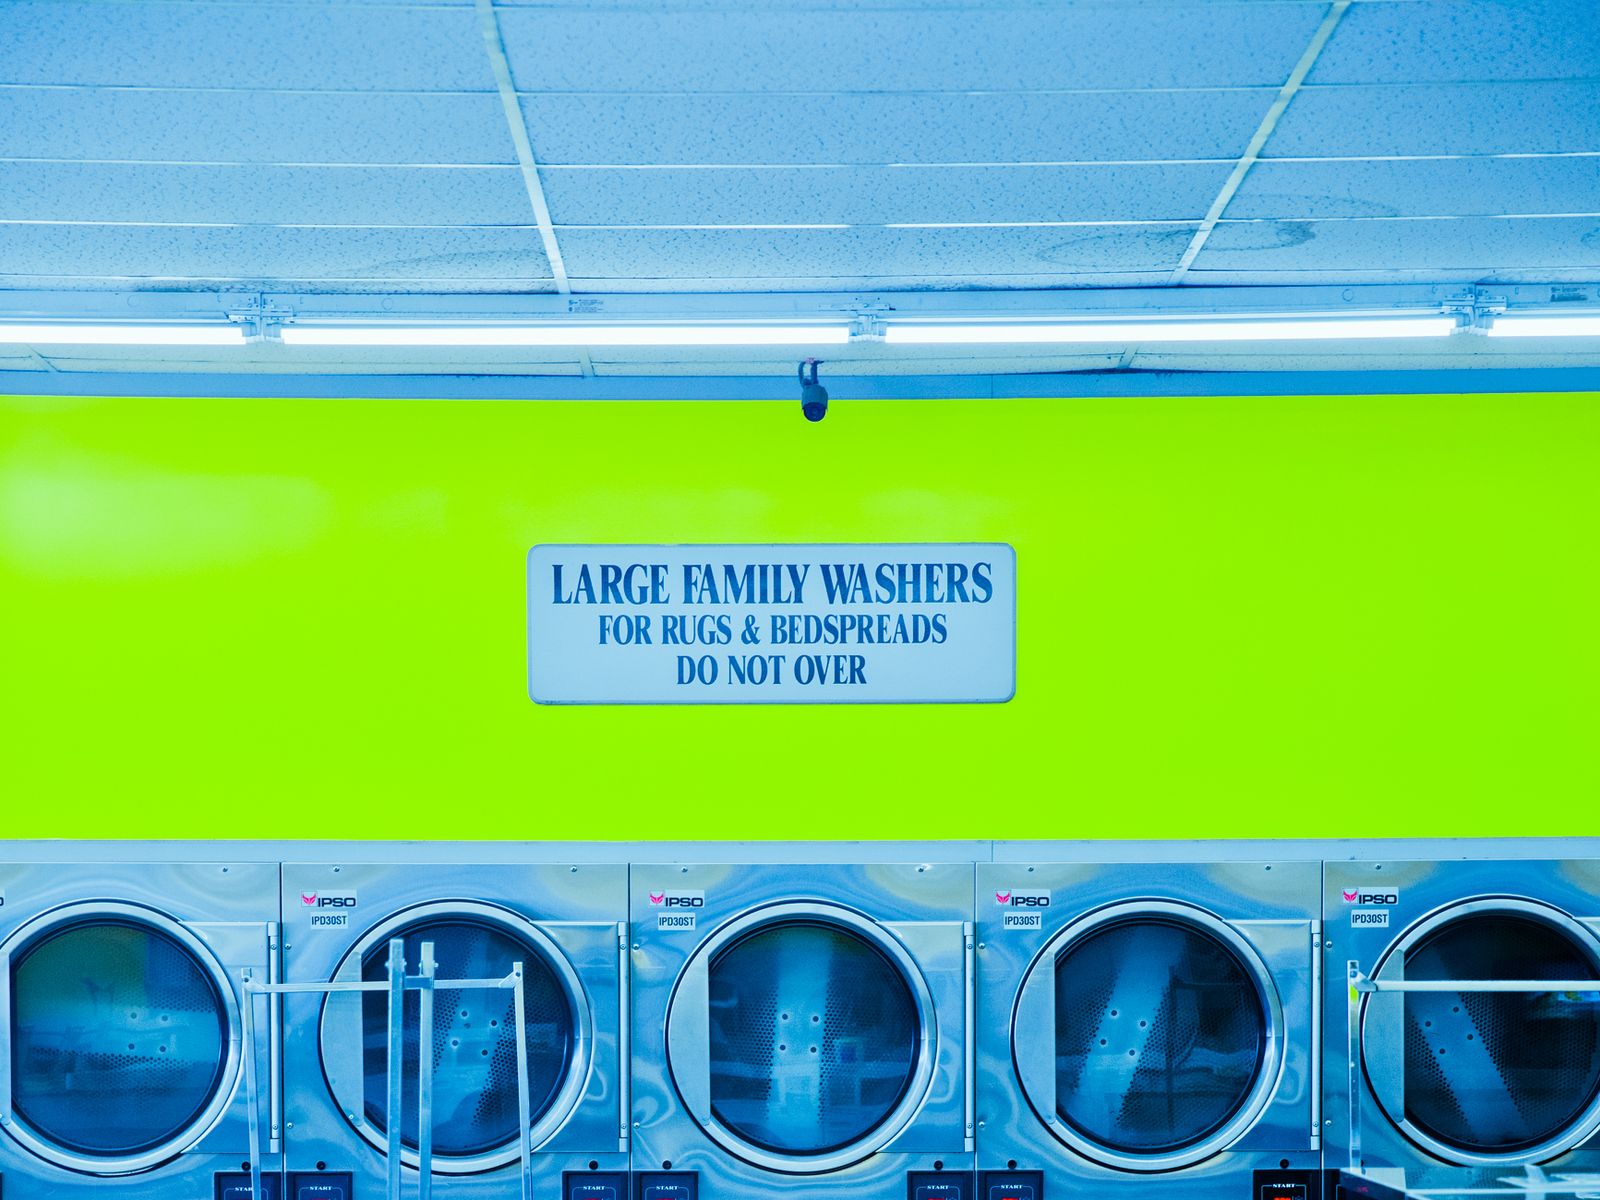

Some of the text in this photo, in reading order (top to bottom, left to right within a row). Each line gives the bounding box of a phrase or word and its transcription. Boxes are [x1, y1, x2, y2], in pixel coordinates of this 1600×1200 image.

[552, 562, 993, 604] LARGE FAMILY WASHERS
[599, 614, 948, 645] FOR RUGS & BEDSPREADS
[677, 655, 867, 685] DO NOT OVER
[318, 897, 356, 907] IPSO
[665, 897, 703, 907] IPSO
[1011, 896, 1049, 906] IPSO
[1359, 894, 1397, 904] IPSO
[311, 916, 347, 925] IPD30ST
[659, 916, 694, 926] IPD30ST
[1004, 916, 1040, 925] IPD30ST
[1352, 914, 1387, 923] IPD30ST
